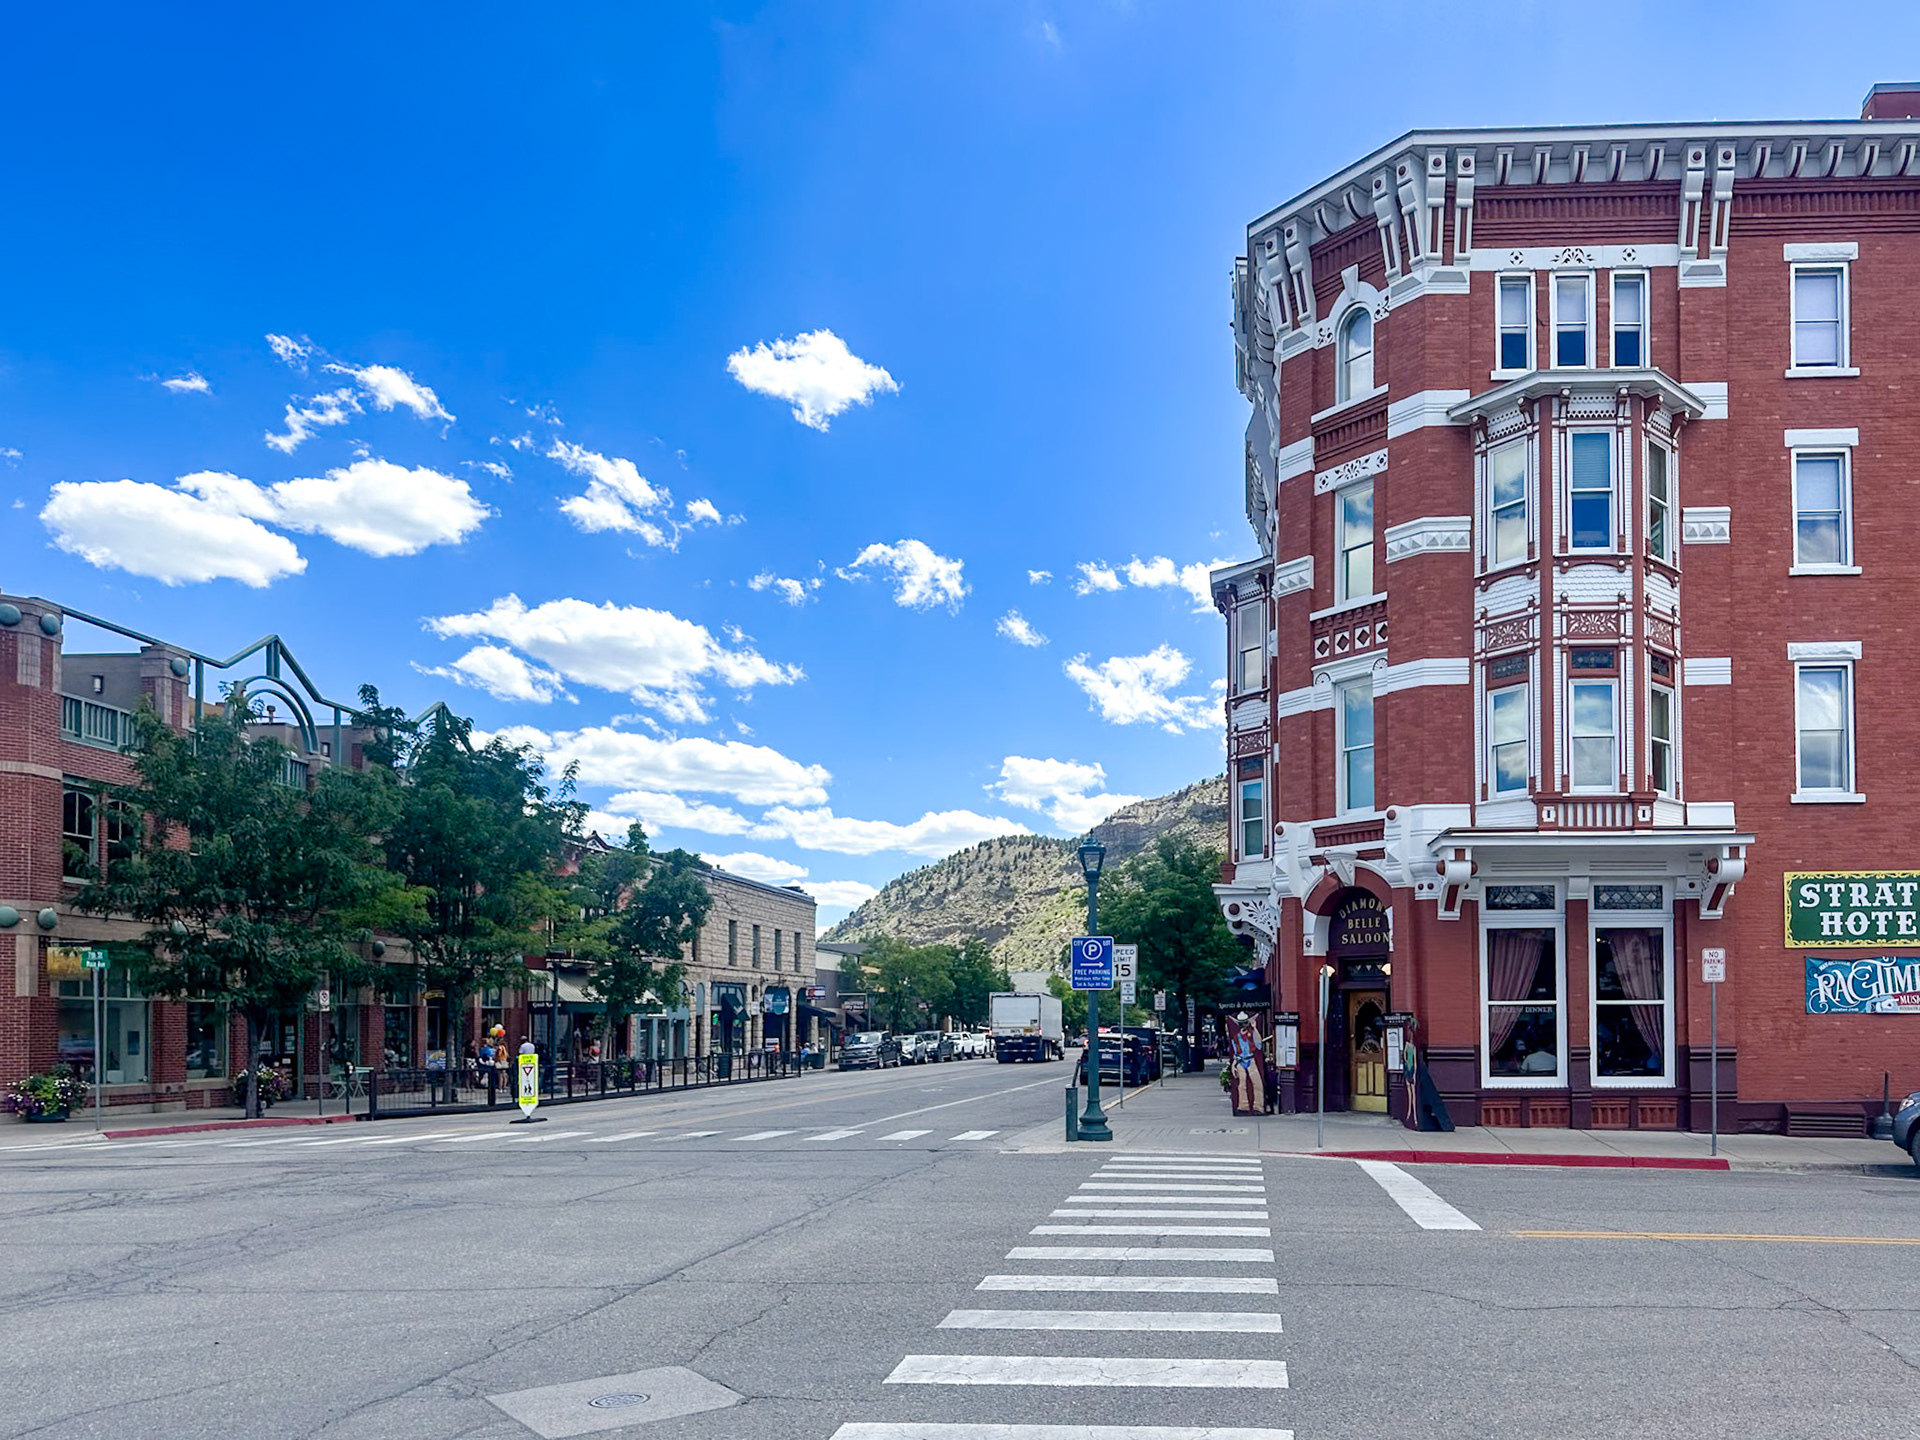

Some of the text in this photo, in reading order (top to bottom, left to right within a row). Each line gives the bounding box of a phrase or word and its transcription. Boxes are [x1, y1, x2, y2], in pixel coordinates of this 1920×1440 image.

[1339, 898, 1384, 919] DIAMON
[1347, 917, 1381, 929] BELLE
[1341, 932, 1389, 944] SALOON
[1074, 968, 1111, 976] FREE PARKING
[1114, 964, 1131, 977] 15
[1900, 994, 1920, 1005] MUSI
